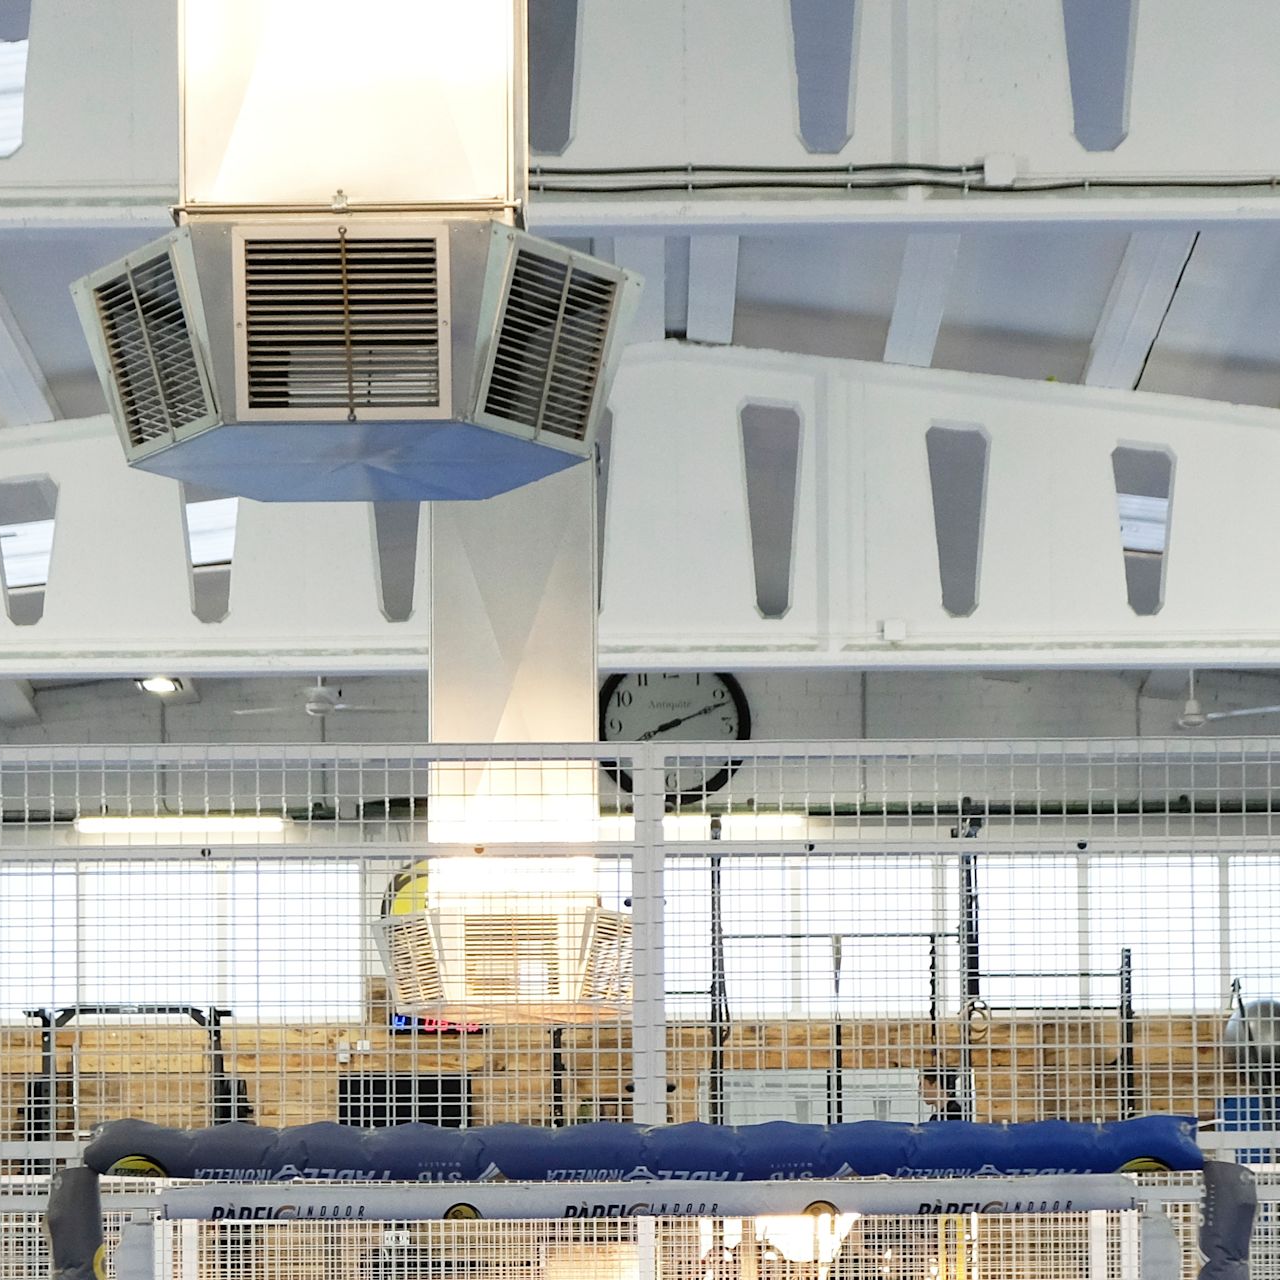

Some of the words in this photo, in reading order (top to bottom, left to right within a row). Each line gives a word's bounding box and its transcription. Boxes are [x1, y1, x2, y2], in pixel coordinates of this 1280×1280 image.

[616, 690, 632, 707] 10
[610, 719, 622, 735] 9
[297, 1205, 365, 1217] INDOOR
[650, 1203, 718, 1214] INDOOR
[1004, 1200, 1073, 1211] INDOOR
